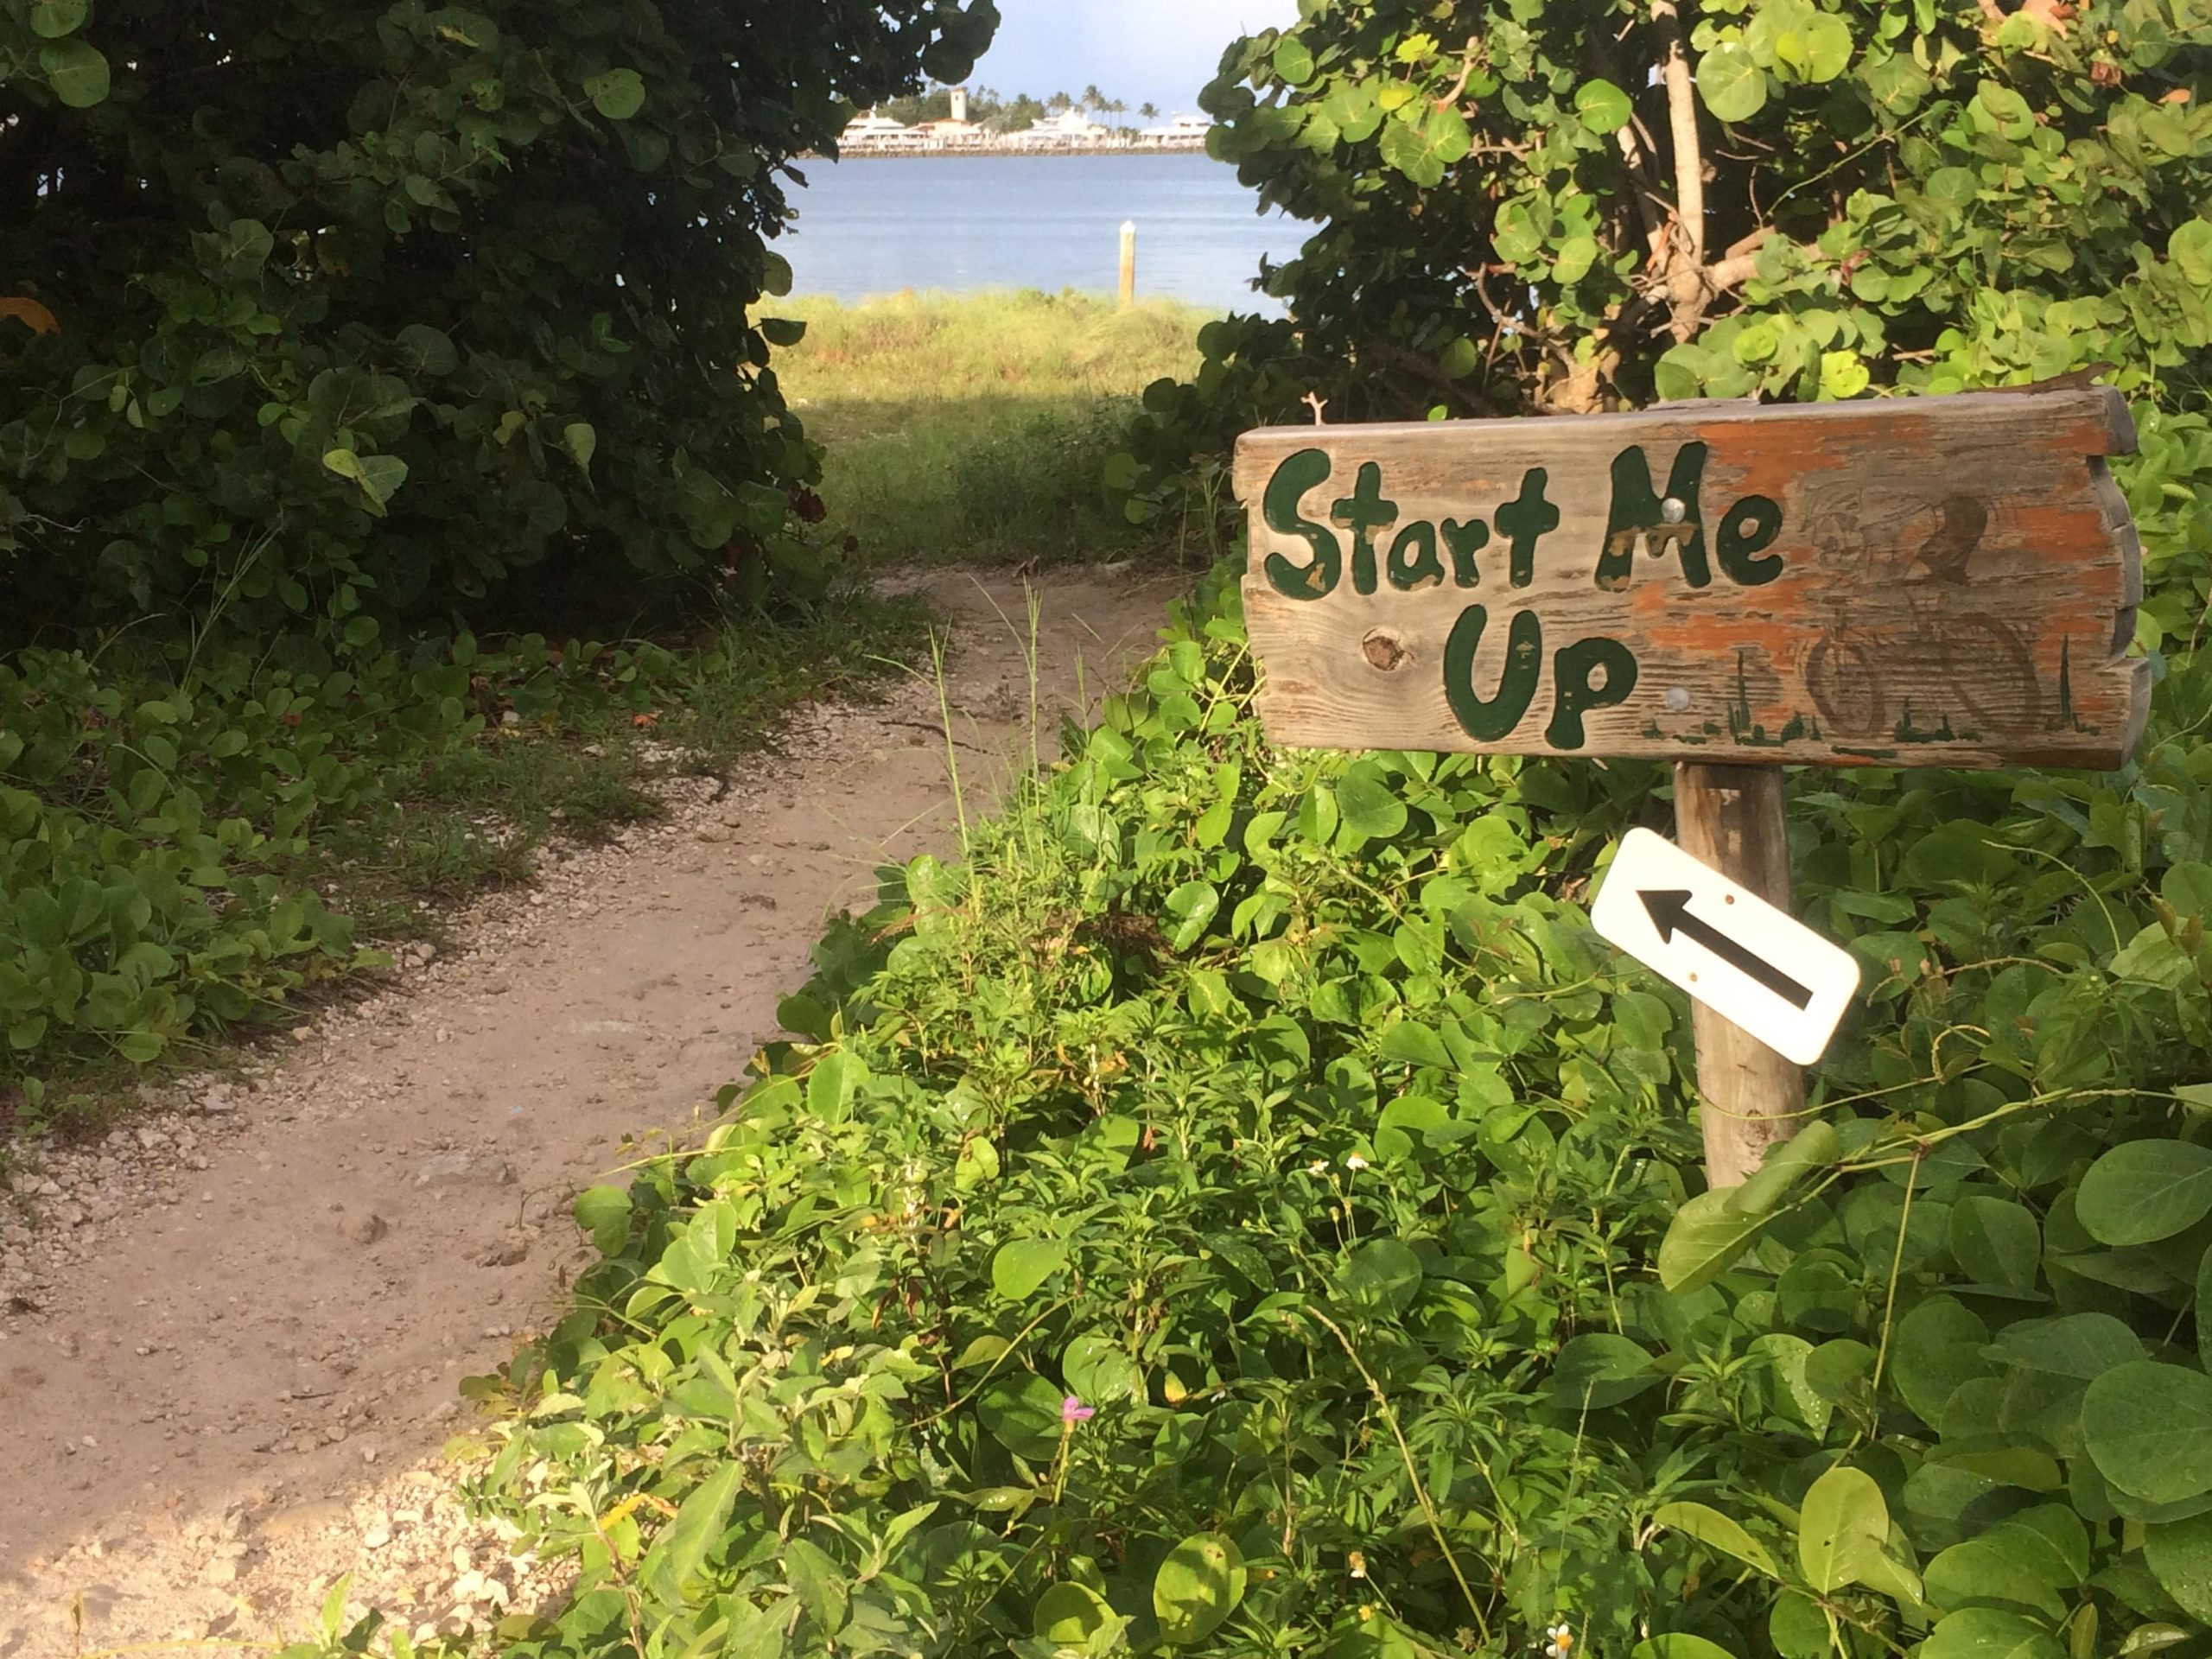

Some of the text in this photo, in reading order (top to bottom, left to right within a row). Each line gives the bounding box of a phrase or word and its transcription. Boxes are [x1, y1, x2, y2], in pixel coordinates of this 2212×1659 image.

[1263, 441, 1783, 601] Start Me
[1443, 604, 1637, 749] Up
